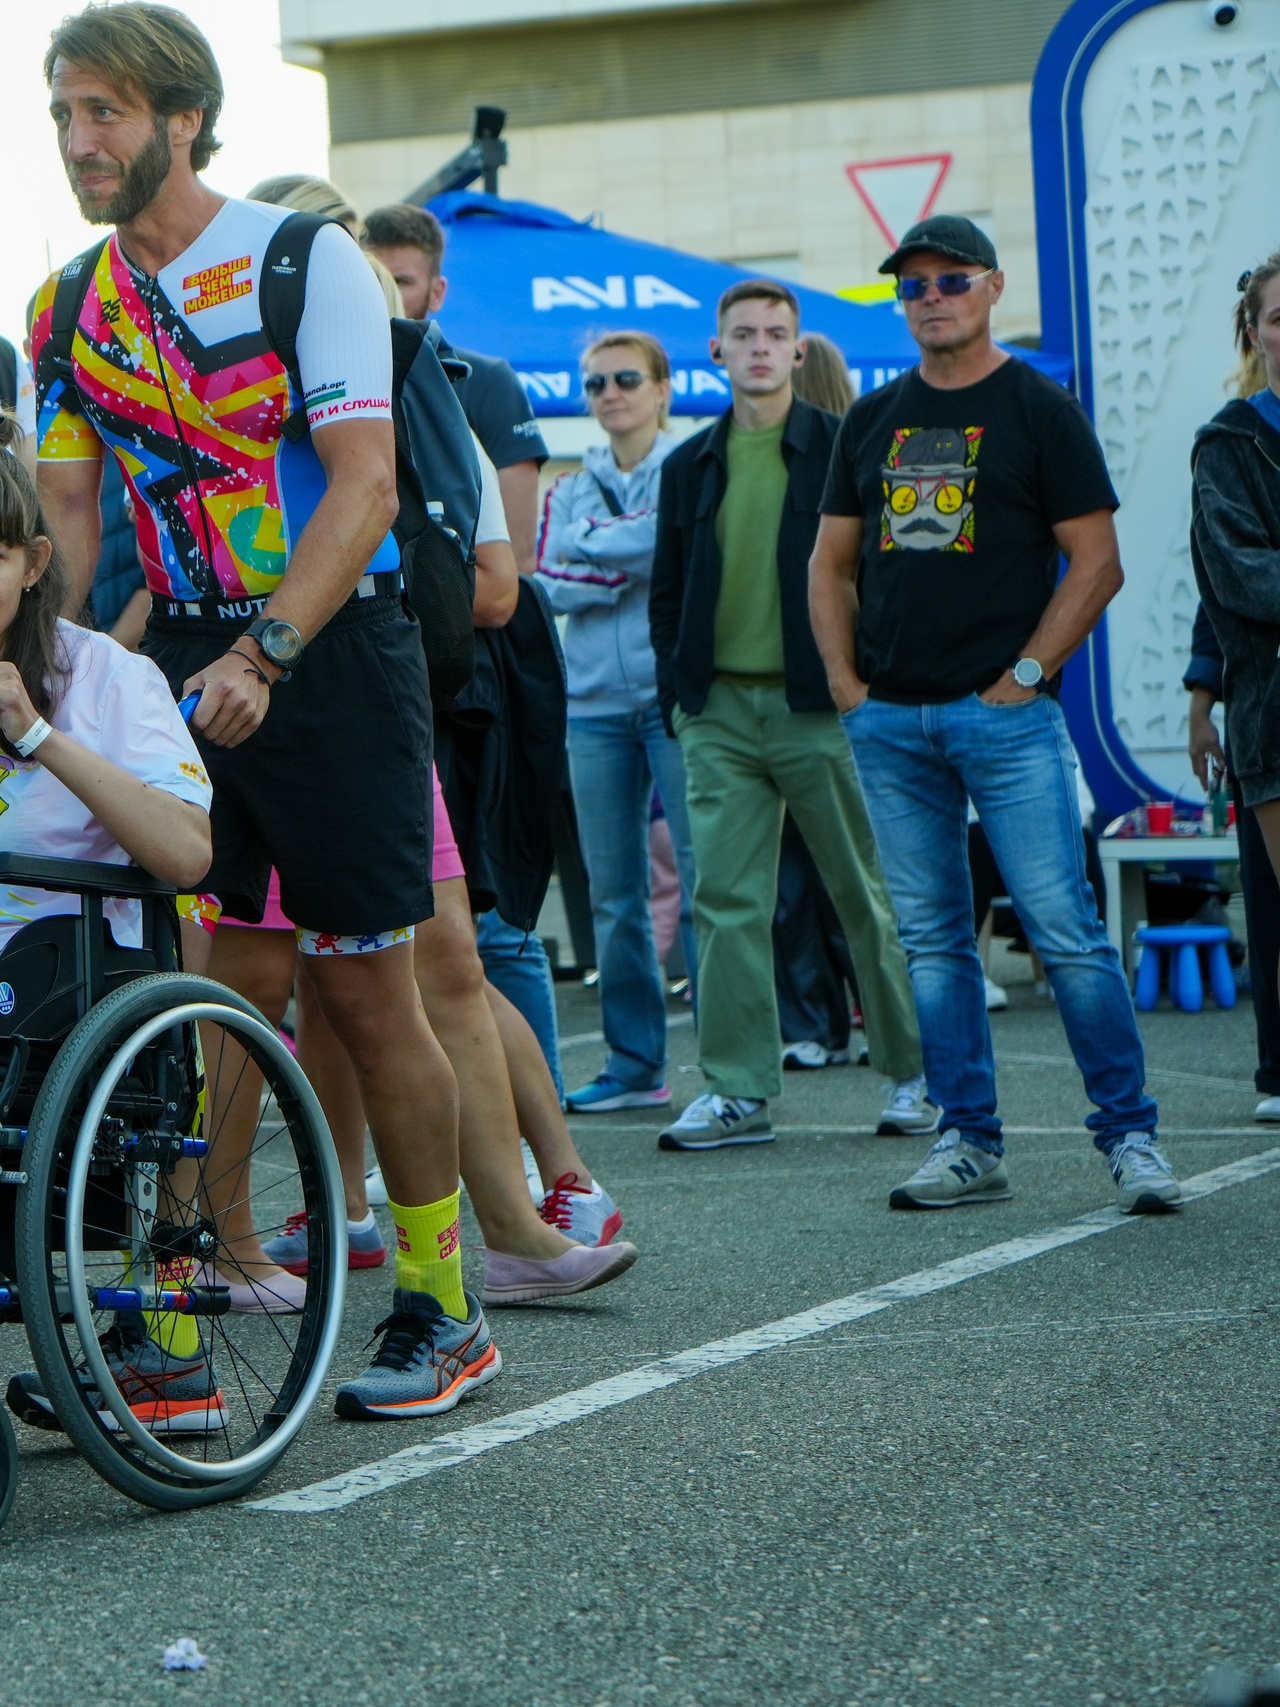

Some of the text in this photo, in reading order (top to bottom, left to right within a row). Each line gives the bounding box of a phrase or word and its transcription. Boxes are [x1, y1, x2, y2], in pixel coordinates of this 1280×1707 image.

[188, 256, 251, 286] БОЛЬШЕ
[201, 273, 232, 293] ЧЕМ
[185, 283, 253, 315] МОЖЕШЬ
[532, 274, 701, 312] AVA
[307, 409, 325, 425] ЕГИ
[328, 404, 340, 416] И
[342, 397, 391, 411] СЛУШАЙ
[948, 1156, 979, 1185] N
